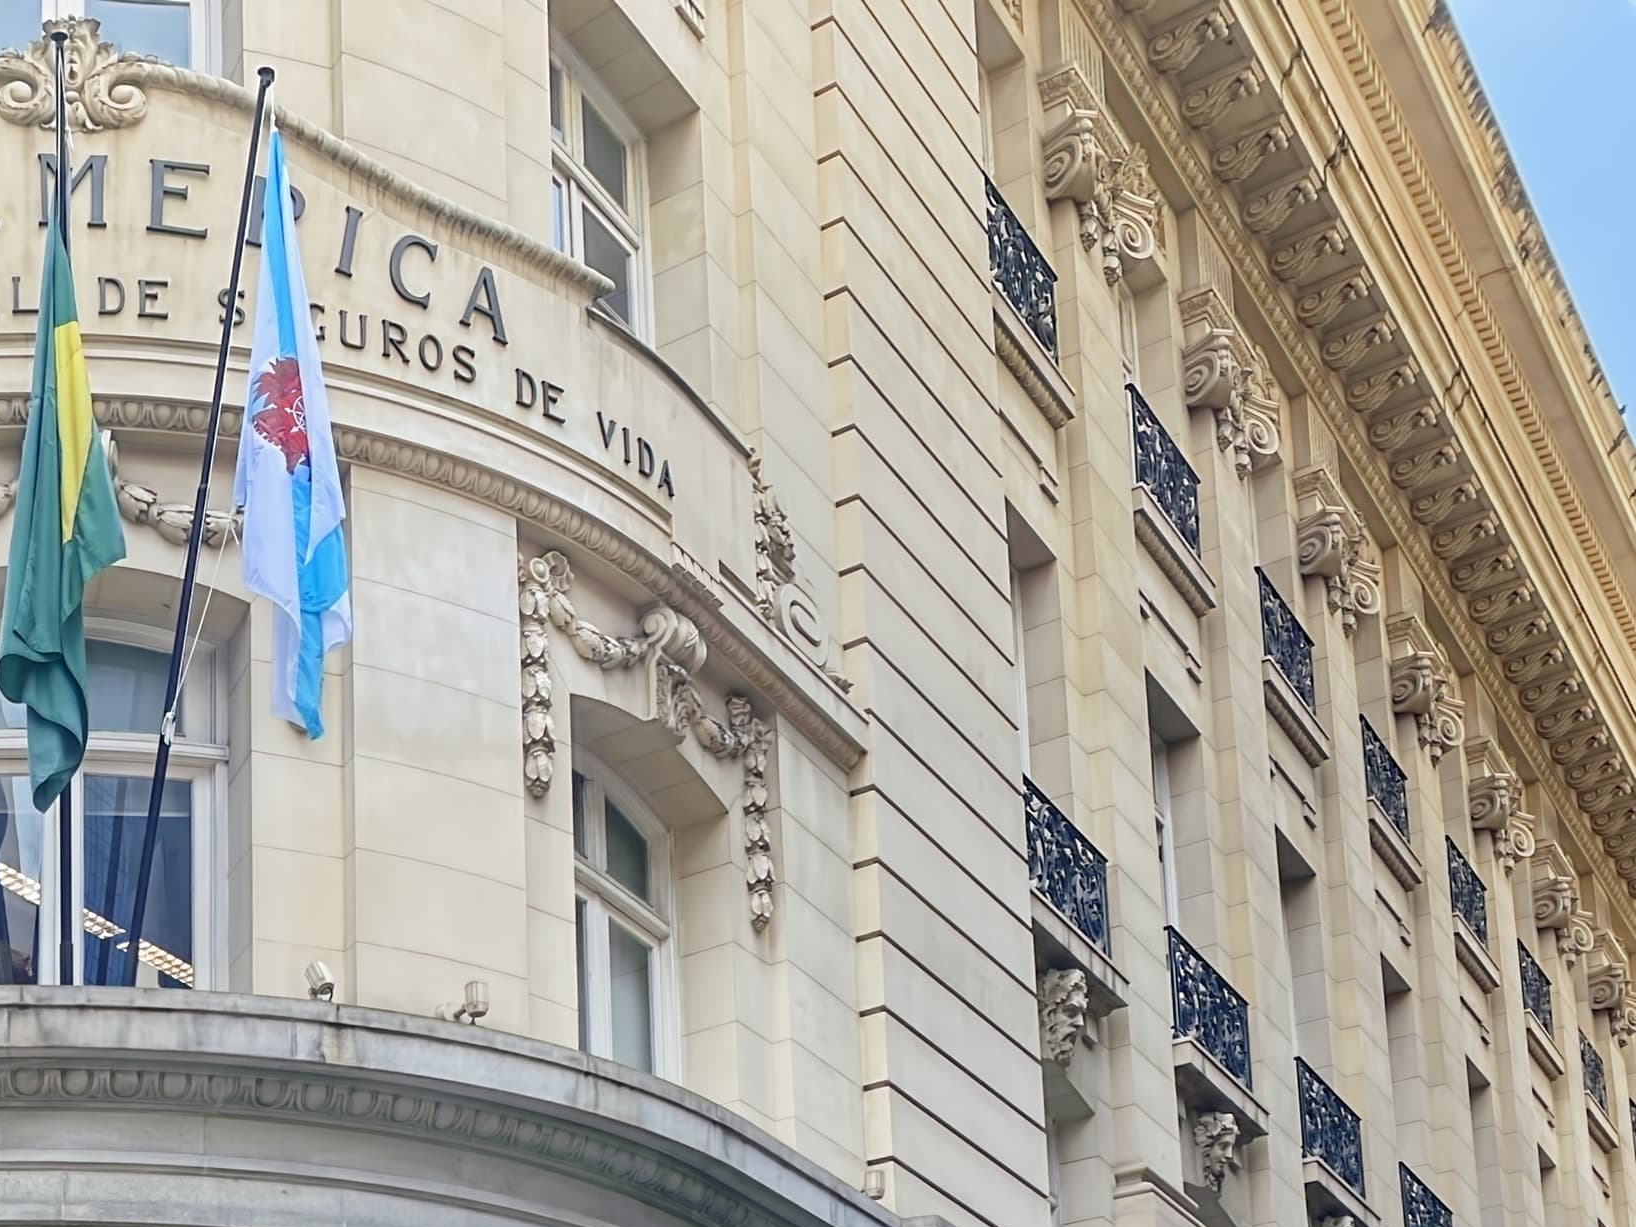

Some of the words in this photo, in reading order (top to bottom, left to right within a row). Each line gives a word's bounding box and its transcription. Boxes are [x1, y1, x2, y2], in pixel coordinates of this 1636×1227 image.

[98, 276, 170, 320] DE
[217, 287, 478, 384] SUROS
[514, 367, 566, 424] DE
[596, 410, 677, 499] VIDA
